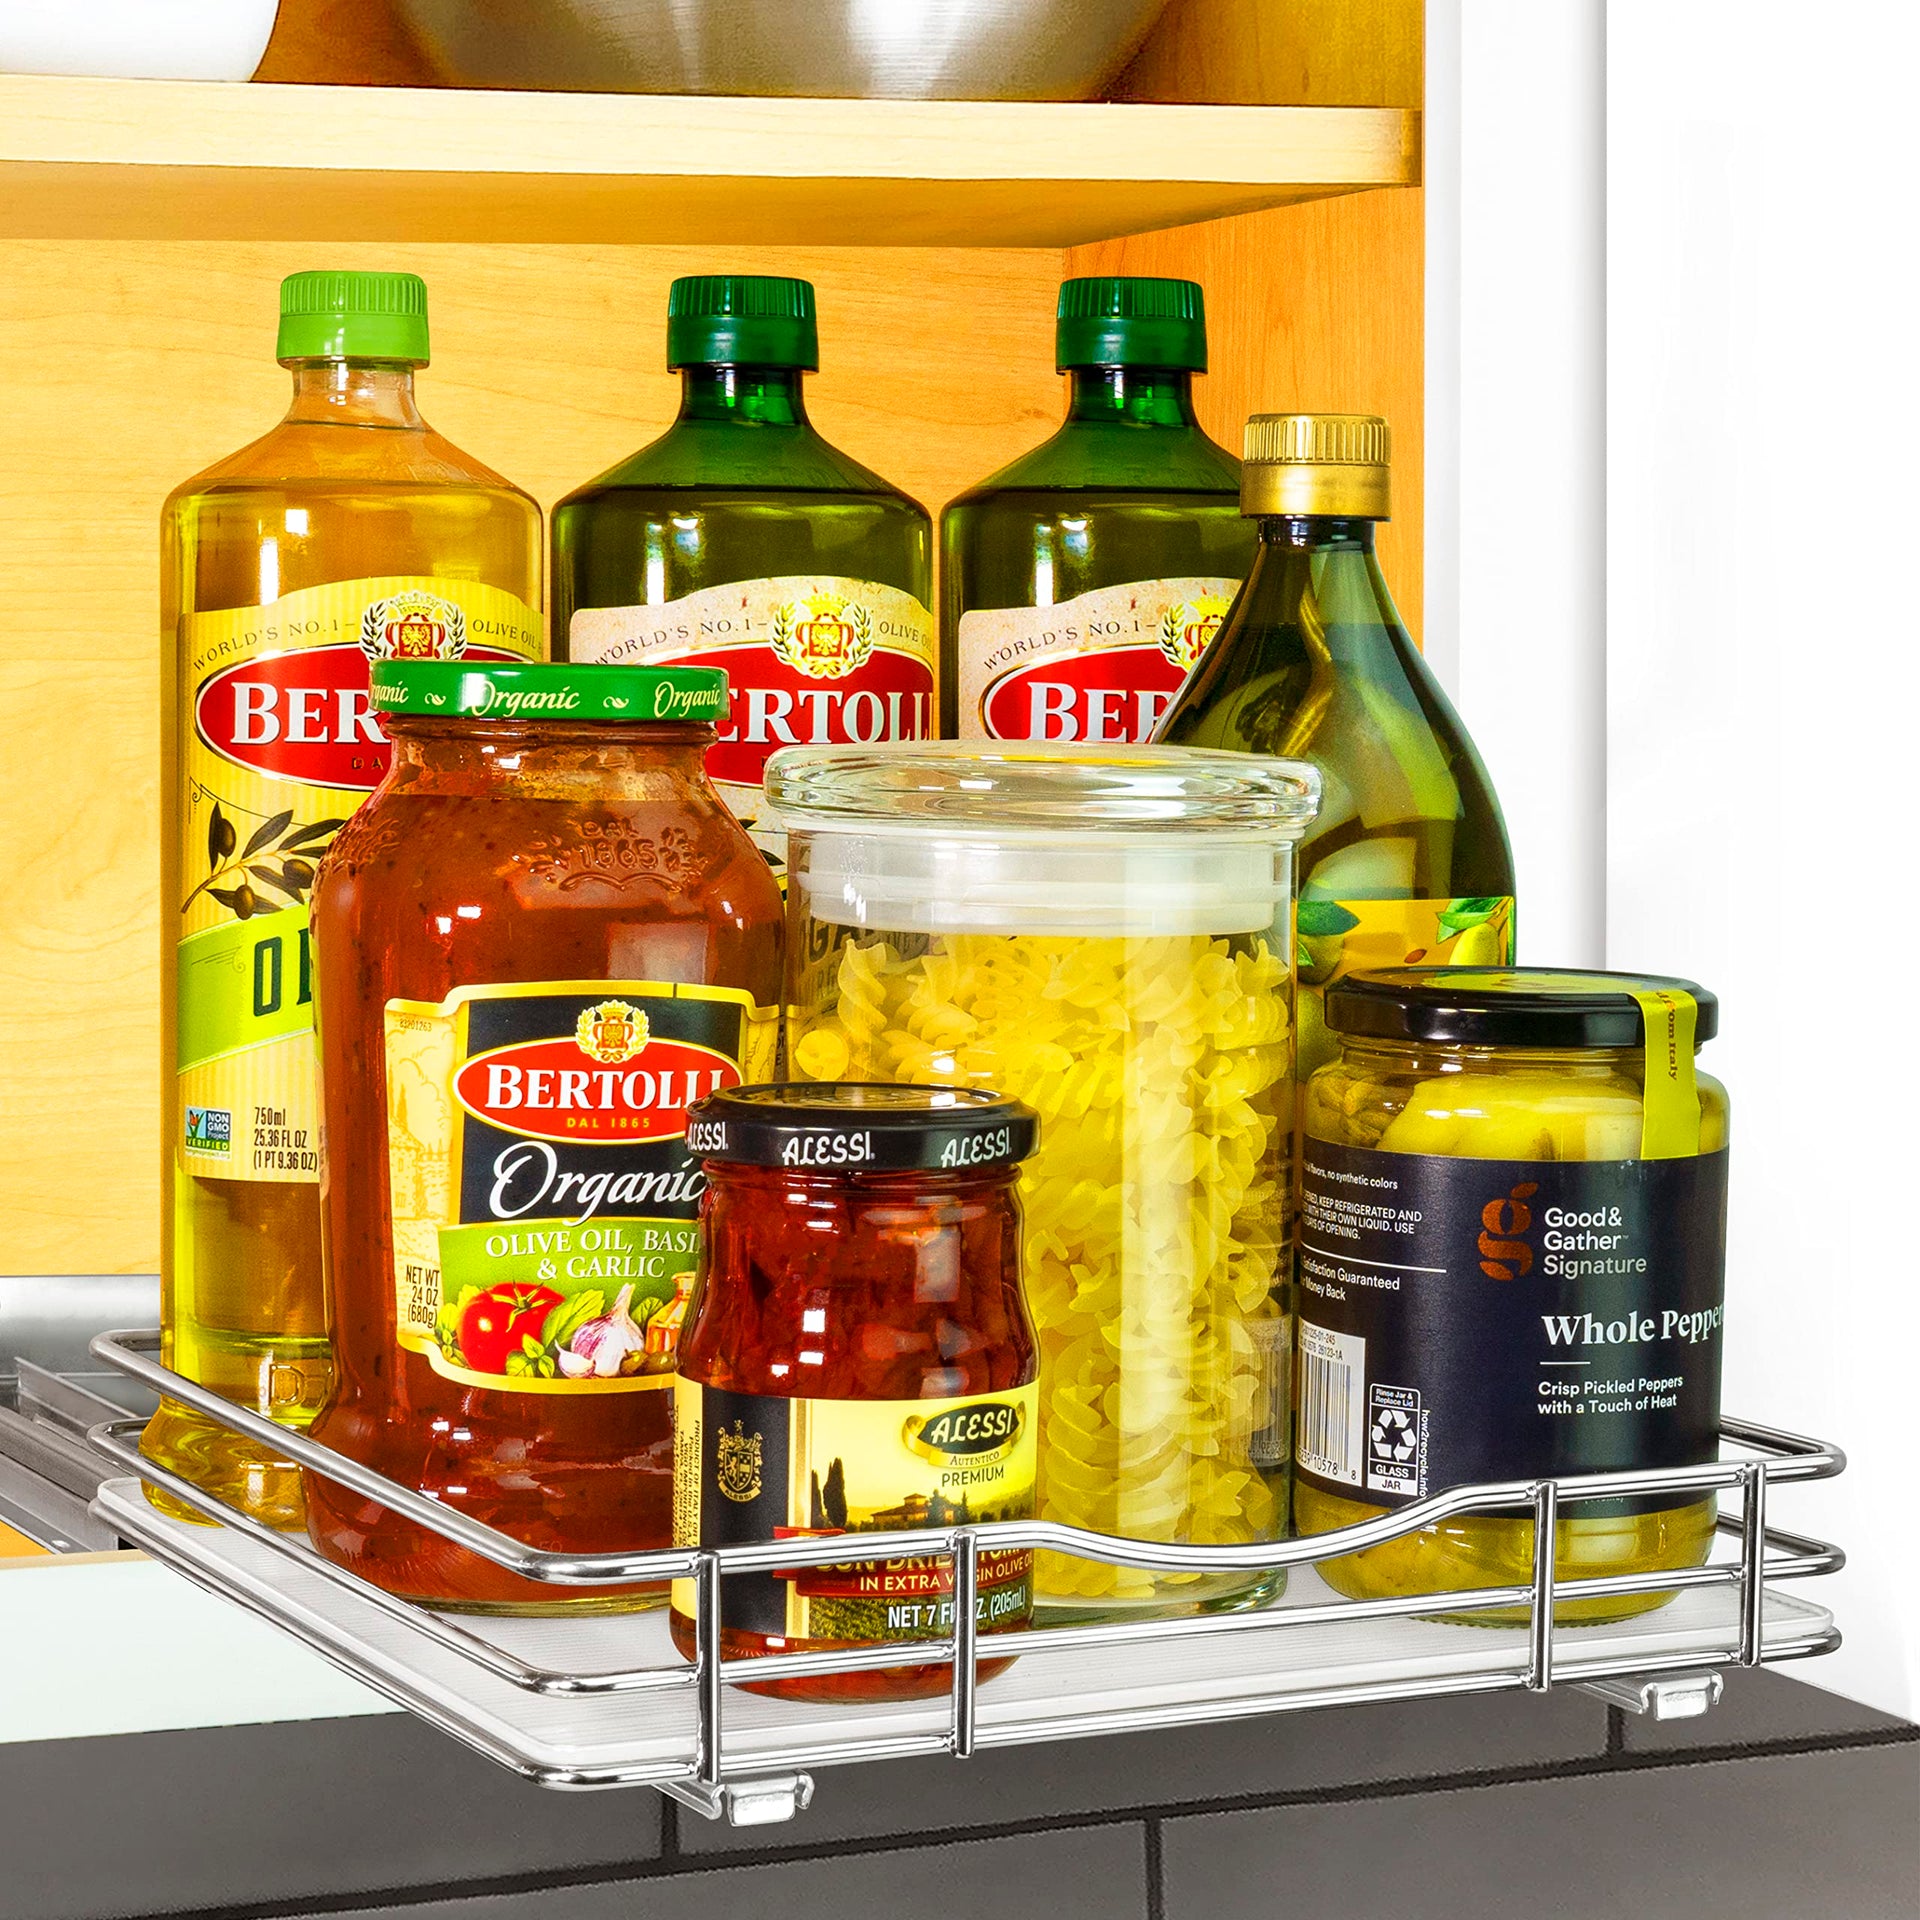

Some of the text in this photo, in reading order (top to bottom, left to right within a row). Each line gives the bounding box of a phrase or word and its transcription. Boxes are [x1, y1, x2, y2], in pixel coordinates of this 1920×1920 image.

[879, 620, 919, 643] OLIVE
[193, 626, 278, 671] WORLD'S
[472, 618, 518, 640] OLIVE
[984, 626, 1078, 671] WORLD'S
[471, 680, 580, 718] Organic
[653, 680, 721, 718] Organic
[1668, 1042, 1678, 1081] Italy
[207, 1112, 229, 1123] NON
[254, 1106, 286, 1126] 750ml
[567, 1117, 651, 1129] DAL 1865
[207, 1122, 230, 1133] GMO
[254, 1128, 308, 1149] 25.36 FL OZ
[782, 1131, 873, 1166] ALESSI
[940, 1126, 1011, 1168] ALESSI
[264, 1151, 276, 1169] PT
[278, 1151, 299, 1170] 9.36
[300, 1152, 318, 1172] OZ)
[489, 1141, 705, 1227] Organic
[1336, 1173, 1369, 1187] synthetic
[1370, 1177, 1398, 1190] colors
[1335, 1200, 1396, 1220] REFRIGERATED
[1398, 1210, 1422, 1223] AND
[1544, 1206, 1623, 1228] Good&
[1326, 1222, 1361, 1240] OPENING.
[1338, 1213, 1357, 1227] OWN
[1358, 1217, 1393, 1232] LIQUID.
[1394, 1222, 1415, 1235] USE
[485, 1229, 699, 1258] OLIVE OIL, BASI
[406, 1265, 441, 1288] NET WT
[536, 1256, 665, 1280] & GARLIC
[1543, 1254, 1647, 1280] Signature
[1337, 1267, 1400, 1291] Guaranteed
[411, 1285, 439, 1305] 24 OZ
[1326, 1283, 1347, 1301] Back
[407, 1302, 438, 1328] (680g)
[1541, 1303, 1723, 1346] Whole Pepper
[1394, 1391, 1407, 1399] Jar
[1538, 1375, 1683, 1397] Crisp Pickled Peppers
[1402, 1399, 1414, 1408] Lid
[1537, 1393, 1677, 1415] with a Touch of Heat
[931, 1408, 1013, 1444] ALESSI
[941, 1465, 1005, 1487] PREMIUM
[1350, 1469, 1357, 1481] 8
[1375, 1464, 1410, 1479] GLASS
[1381, 1479, 1402, 1491] JAR
[859, 1577, 880, 1591] IN
[884, 1573, 941, 1592] EXTRA
[996, 1556, 1024, 1578] OLIVE
[888, 1605, 920, 1629] NET
[926, 1604, 936, 1627] 7
